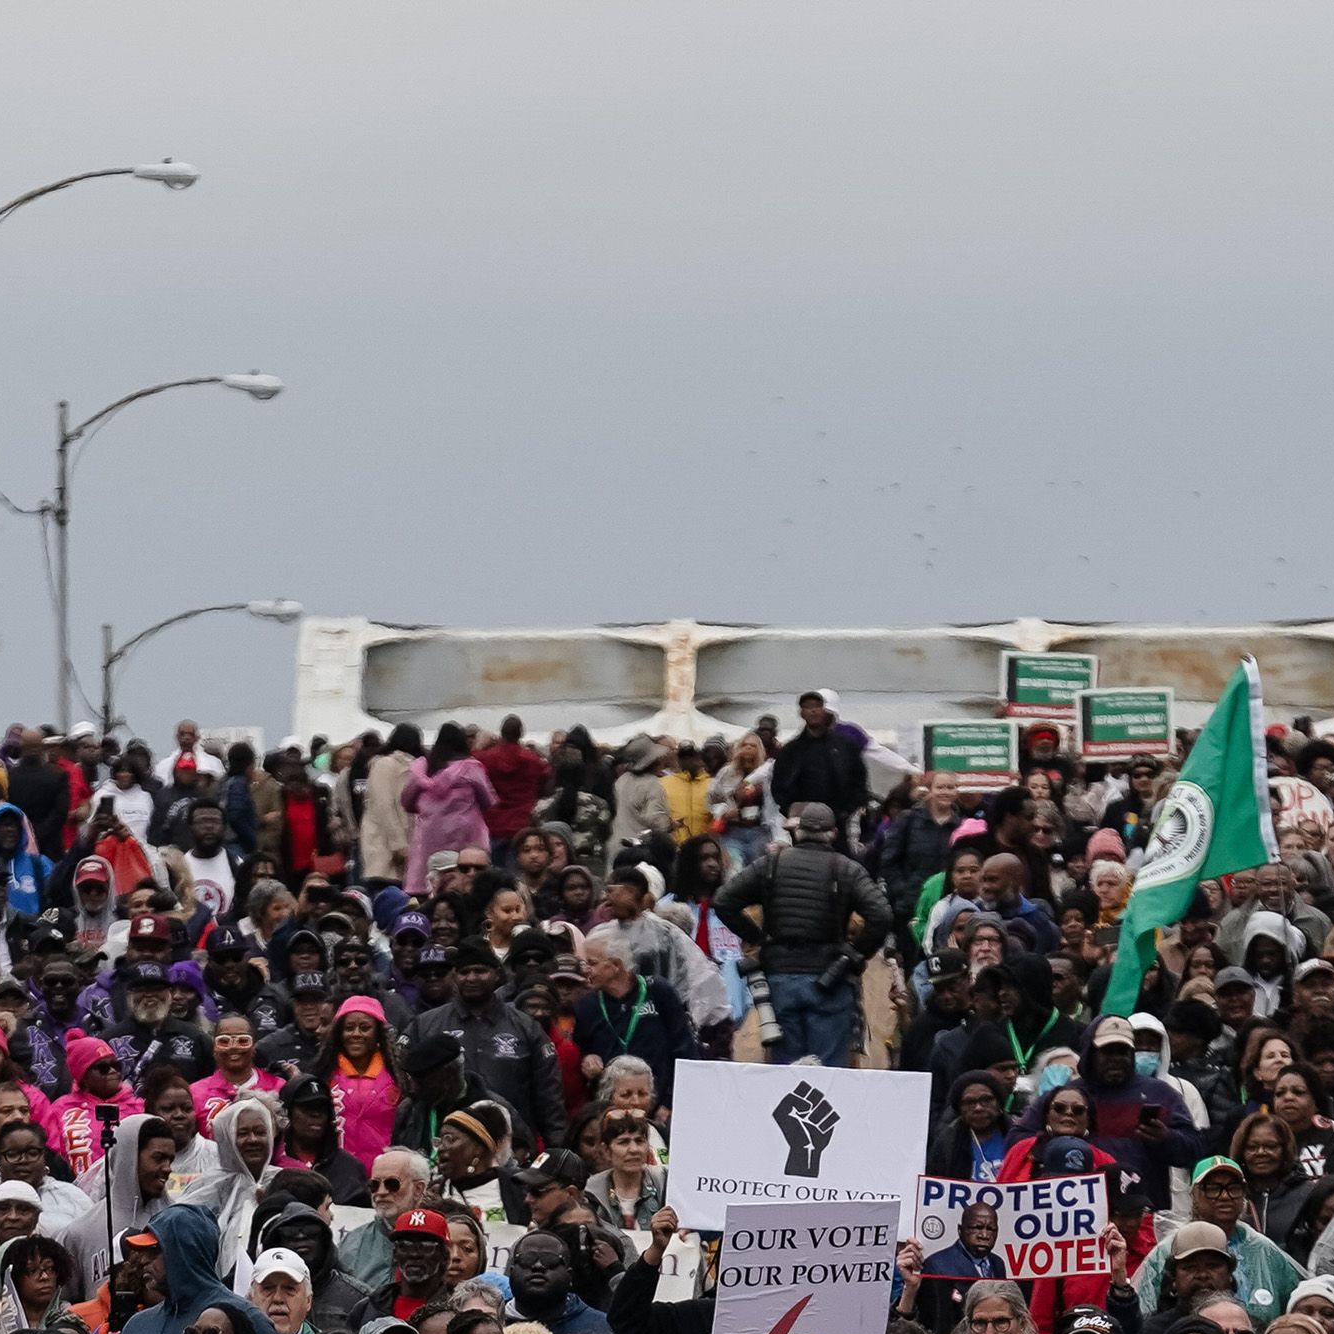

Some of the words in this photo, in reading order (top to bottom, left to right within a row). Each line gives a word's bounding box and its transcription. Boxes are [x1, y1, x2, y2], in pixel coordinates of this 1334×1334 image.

[696, 1175, 792, 1198] PROTECT
[795, 1183, 843, 1201] OUR
[923, 1177, 1101, 1212] PROTECT
[731, 1227, 798, 1251] OUR
[807, 1224, 889, 1249] VOTE
[1014, 1208, 1097, 1239] OUR
[1005, 1237, 1108, 1276] VOTE!
[719, 1263, 783, 1288] OUR
[789, 1261, 892, 1286] POWER
